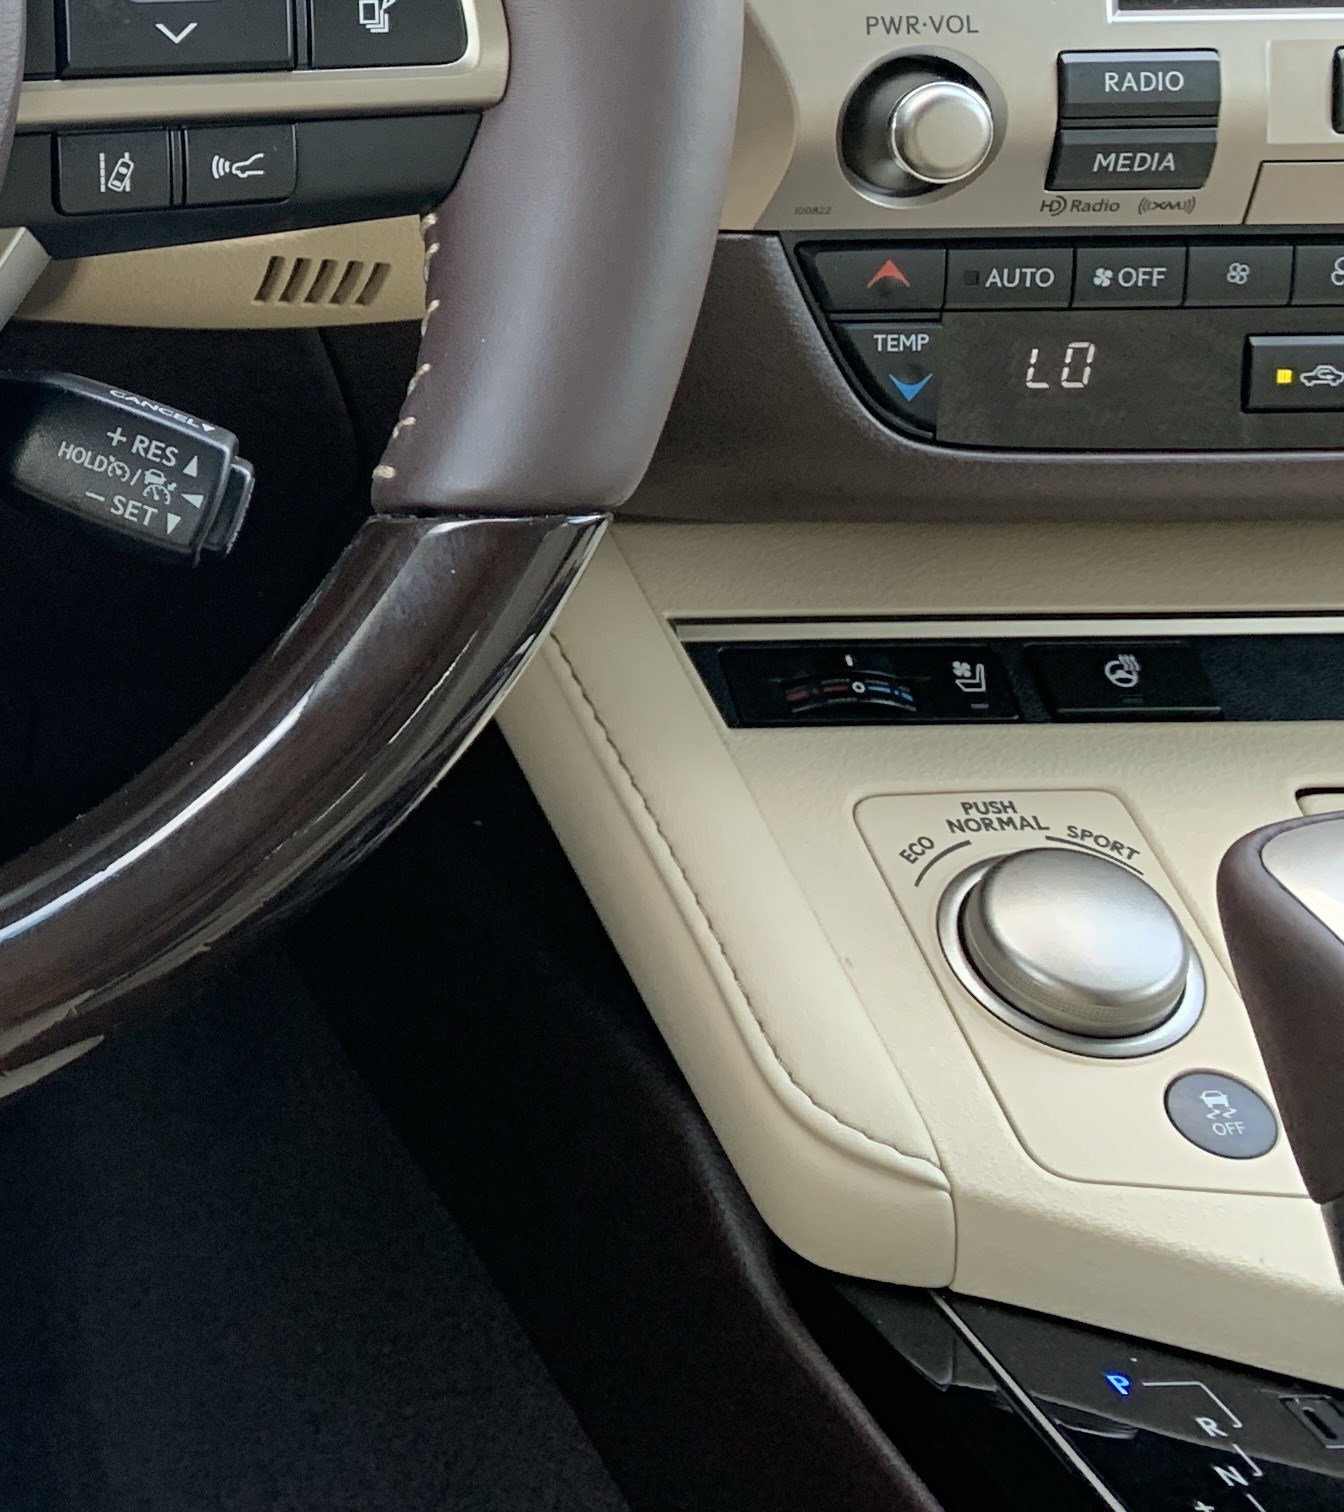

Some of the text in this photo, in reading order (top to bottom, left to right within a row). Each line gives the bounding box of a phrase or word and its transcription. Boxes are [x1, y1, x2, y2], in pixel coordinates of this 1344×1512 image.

[1104, 71, 1185, 92] RADIO
[1092, 152, 1176, 173] MEDIA
[1070, 198, 1121, 214] Radio
[984, 267, 1055, 288] AUTO
[1118, 267, 1167, 287] OFF
[874, 334, 929, 353] TEMP
[110, 389, 200, 428] CANCEL
[132, 434, 179, 467] RES
[110, 496, 159, 527] SET
[960, 801, 1017, 816] PUSH
[945, 816, 1050, 835] NORMAL
[899, 835, 936, 866] ECO
[1066, 824, 1141, 862] SPORT
[1213, 1121, 1245, 1136] OFF
[1106, 1373, 1130, 1395] P
[1195, 1417, 1228, 1437] R
[1213, 1465, 1249, 1487] N
